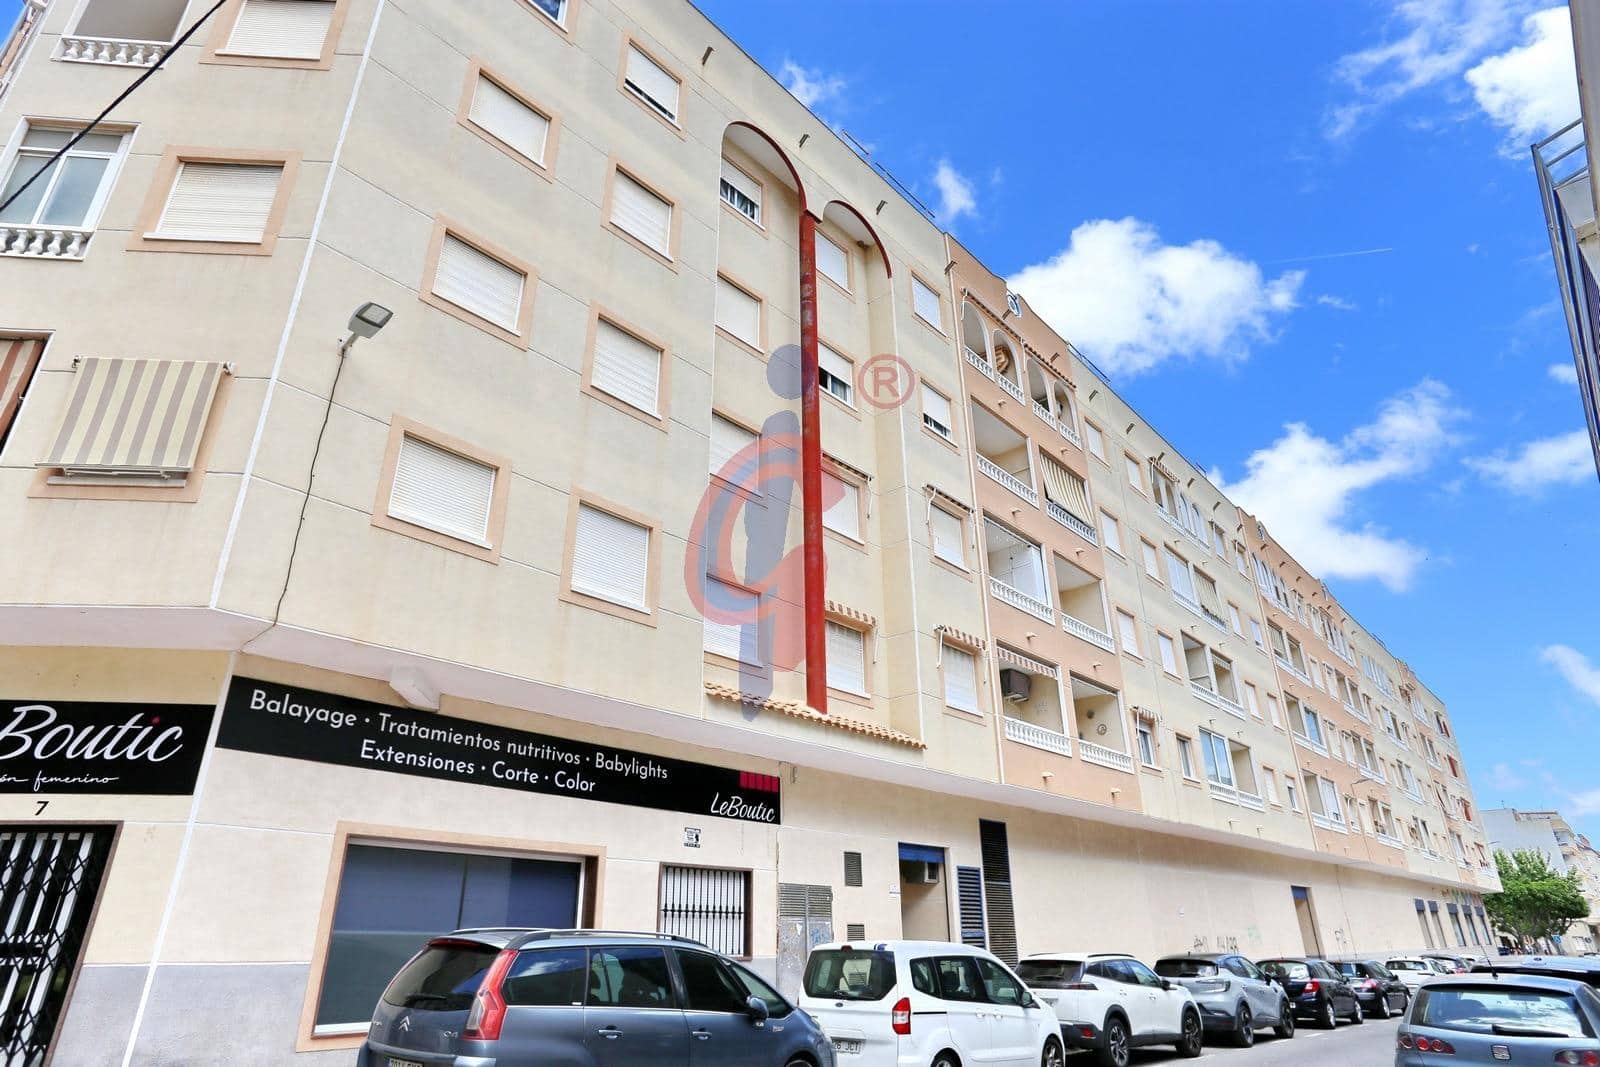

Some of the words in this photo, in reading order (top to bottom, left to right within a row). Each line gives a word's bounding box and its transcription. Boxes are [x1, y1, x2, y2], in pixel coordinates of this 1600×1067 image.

[249, 688, 357, 729] Balayage
[378, 712, 502, 752] Tratamientos
[506, 741, 581, 765] nutritivos
[595, 751, 669, 780] Babylights
[33, 769, 120, 792] femenino
[360, 738, 475, 775] Extensiones
[492, 760, 540, 785] Corte
[554, 770, 597, 793] Color
[35, 800, 50, 816] 7
[710, 791, 776, 822] LeBoutic
